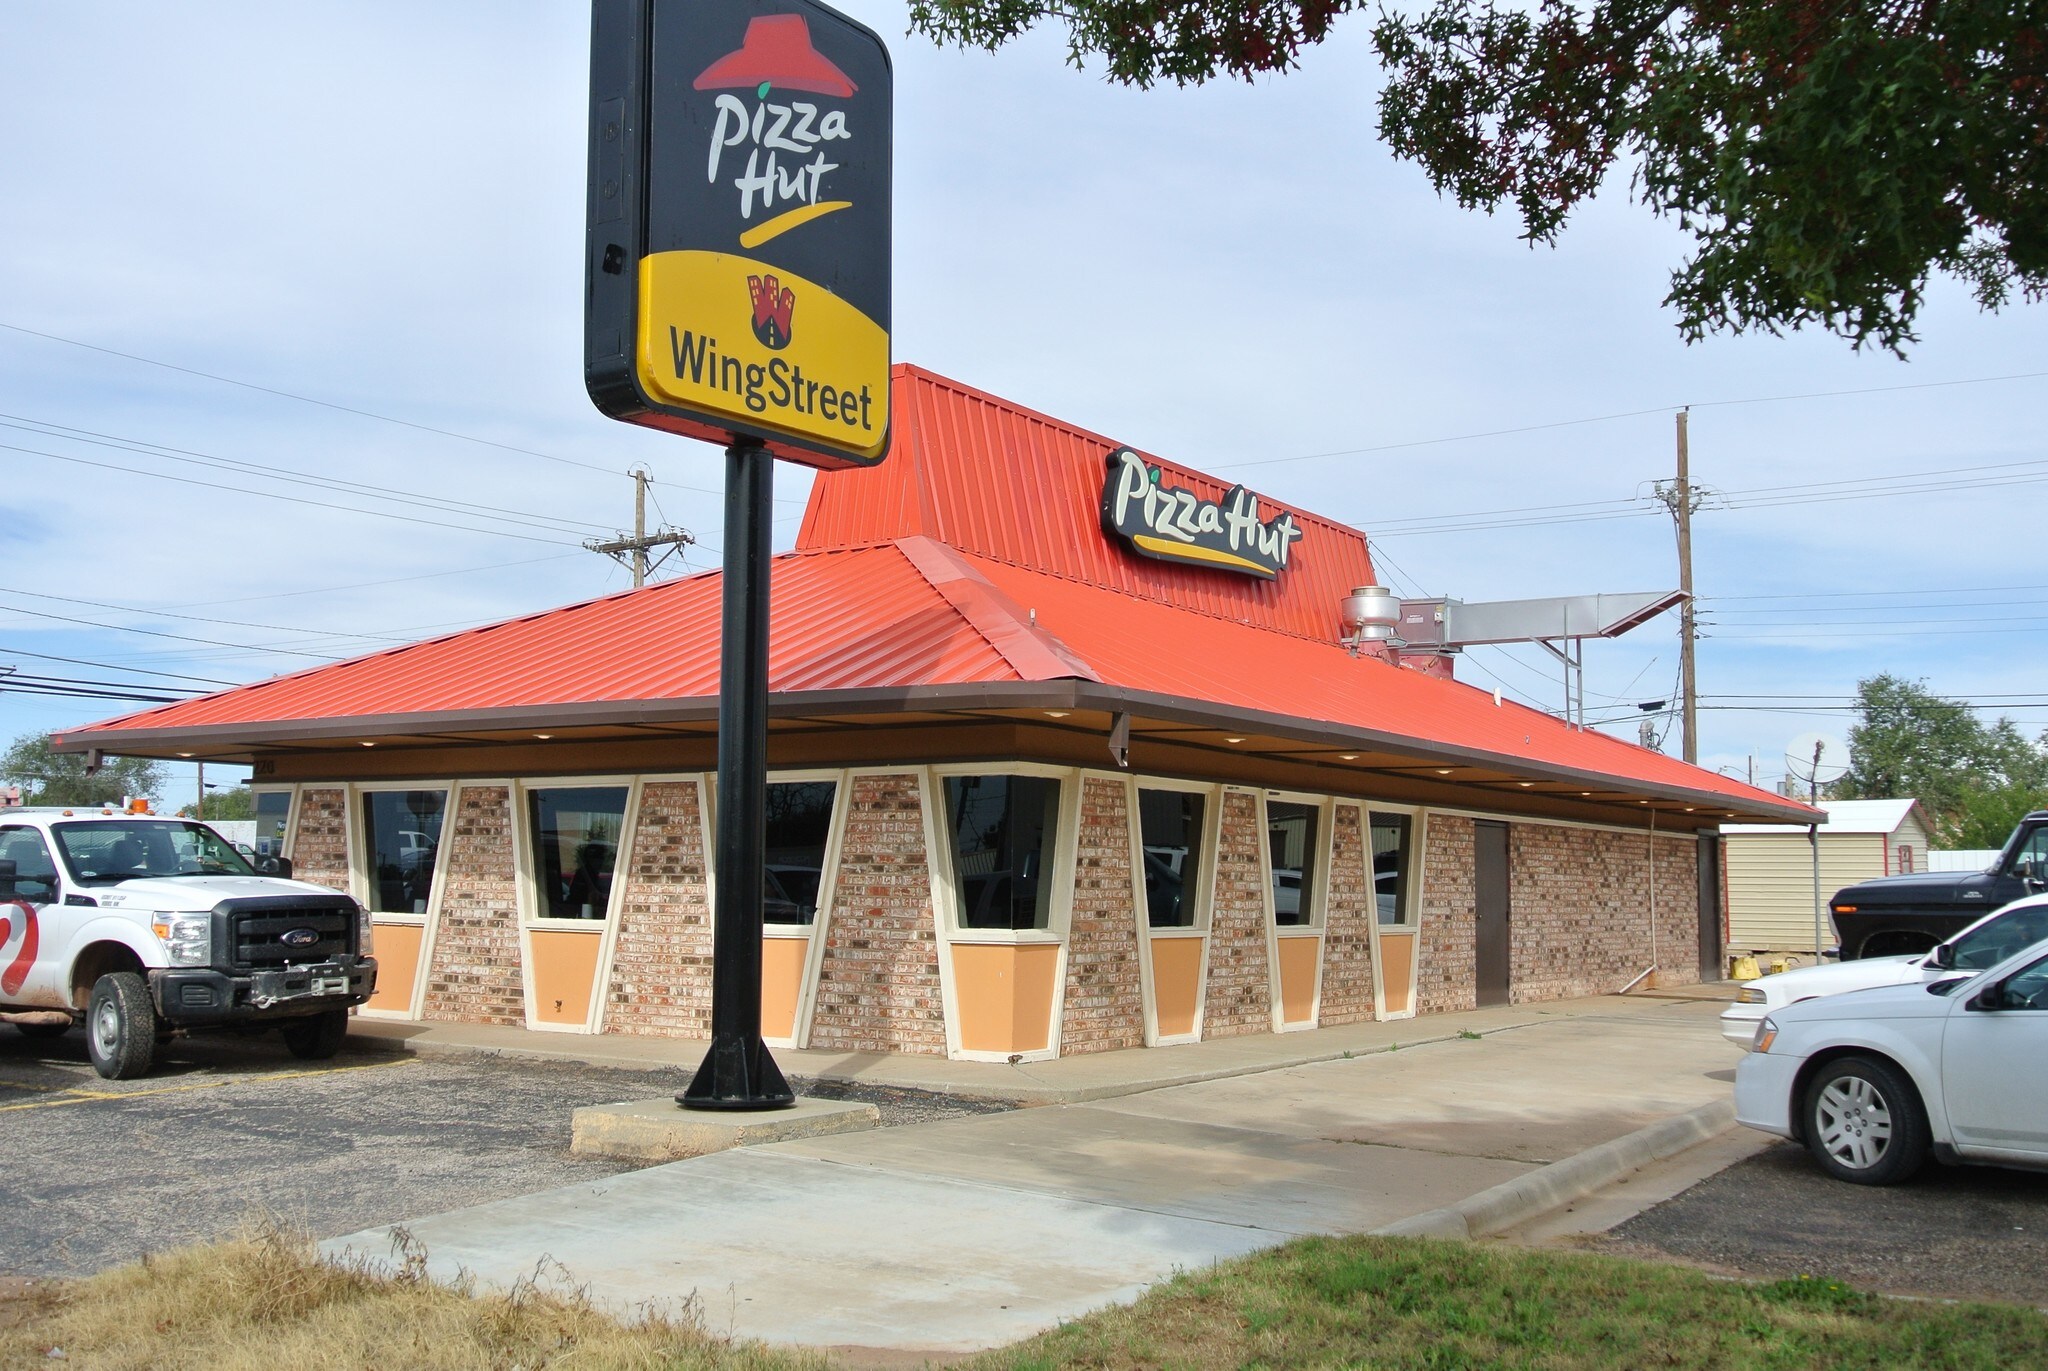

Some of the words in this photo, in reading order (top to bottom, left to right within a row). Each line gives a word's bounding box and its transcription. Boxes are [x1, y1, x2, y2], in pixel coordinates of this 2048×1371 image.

[708, 83, 851, 183] Pizza
[734, 148, 839, 219] Hut
[670, 325, 872, 431] WingStreet
[1115, 451, 1223, 543] Pizza
[1225, 489, 1302, 565] Hut
[292, 935, 313, 944] Ford
